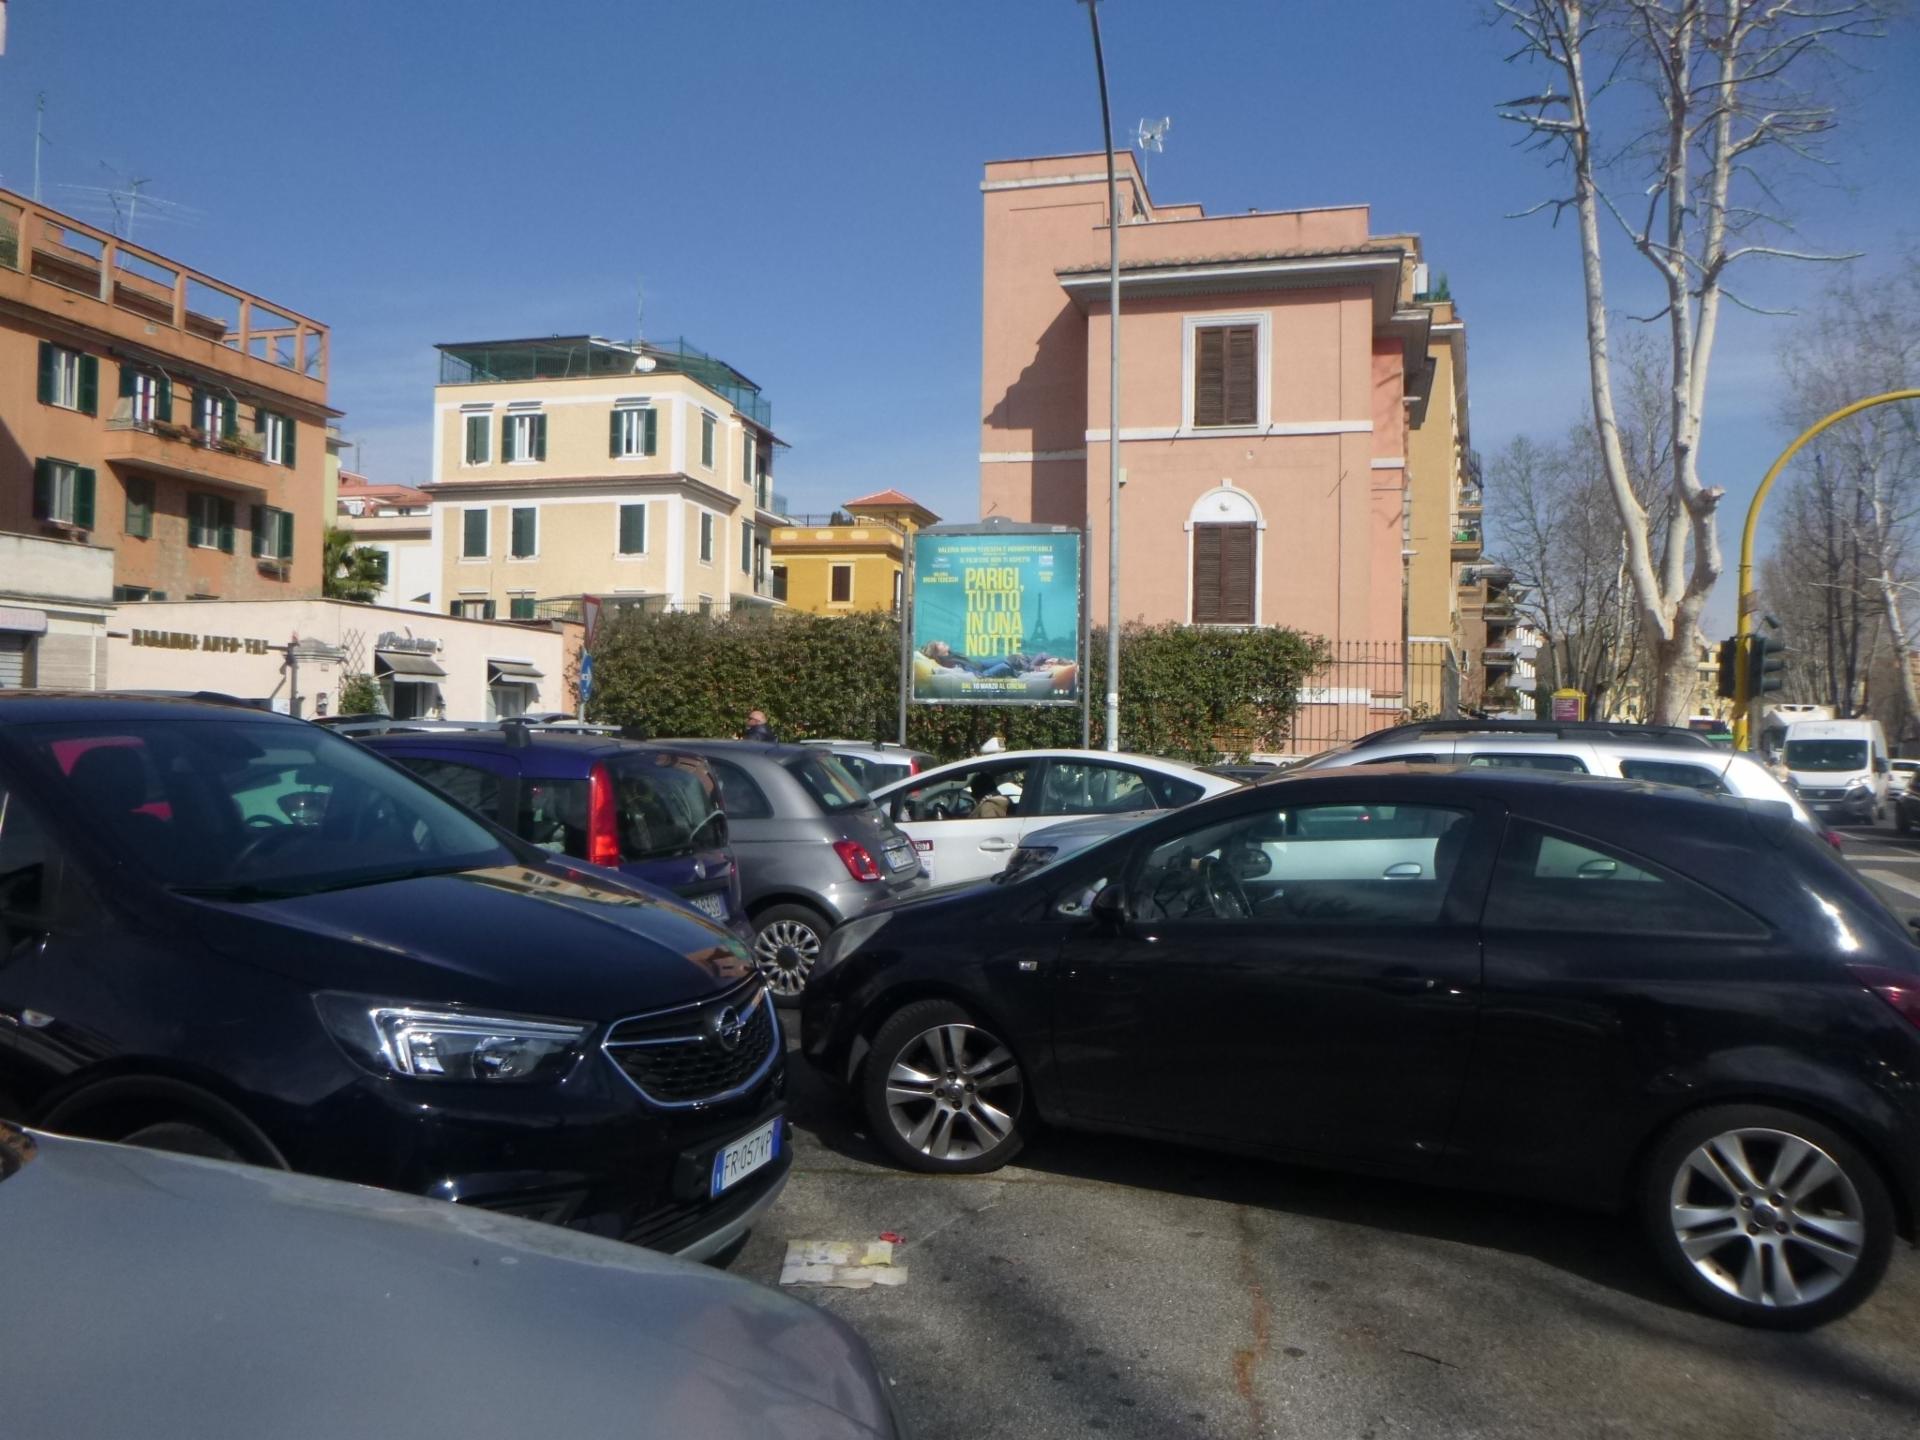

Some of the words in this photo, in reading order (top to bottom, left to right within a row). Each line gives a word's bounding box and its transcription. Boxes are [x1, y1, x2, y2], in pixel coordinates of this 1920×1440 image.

[965, 567, 1024, 592] PARIGI,
[965, 591, 1020, 612] TUTTO
[966, 612, 983, 634] IN
[987, 612, 1023, 634] UNA
[966, 634, 1022, 657] NOTTE
